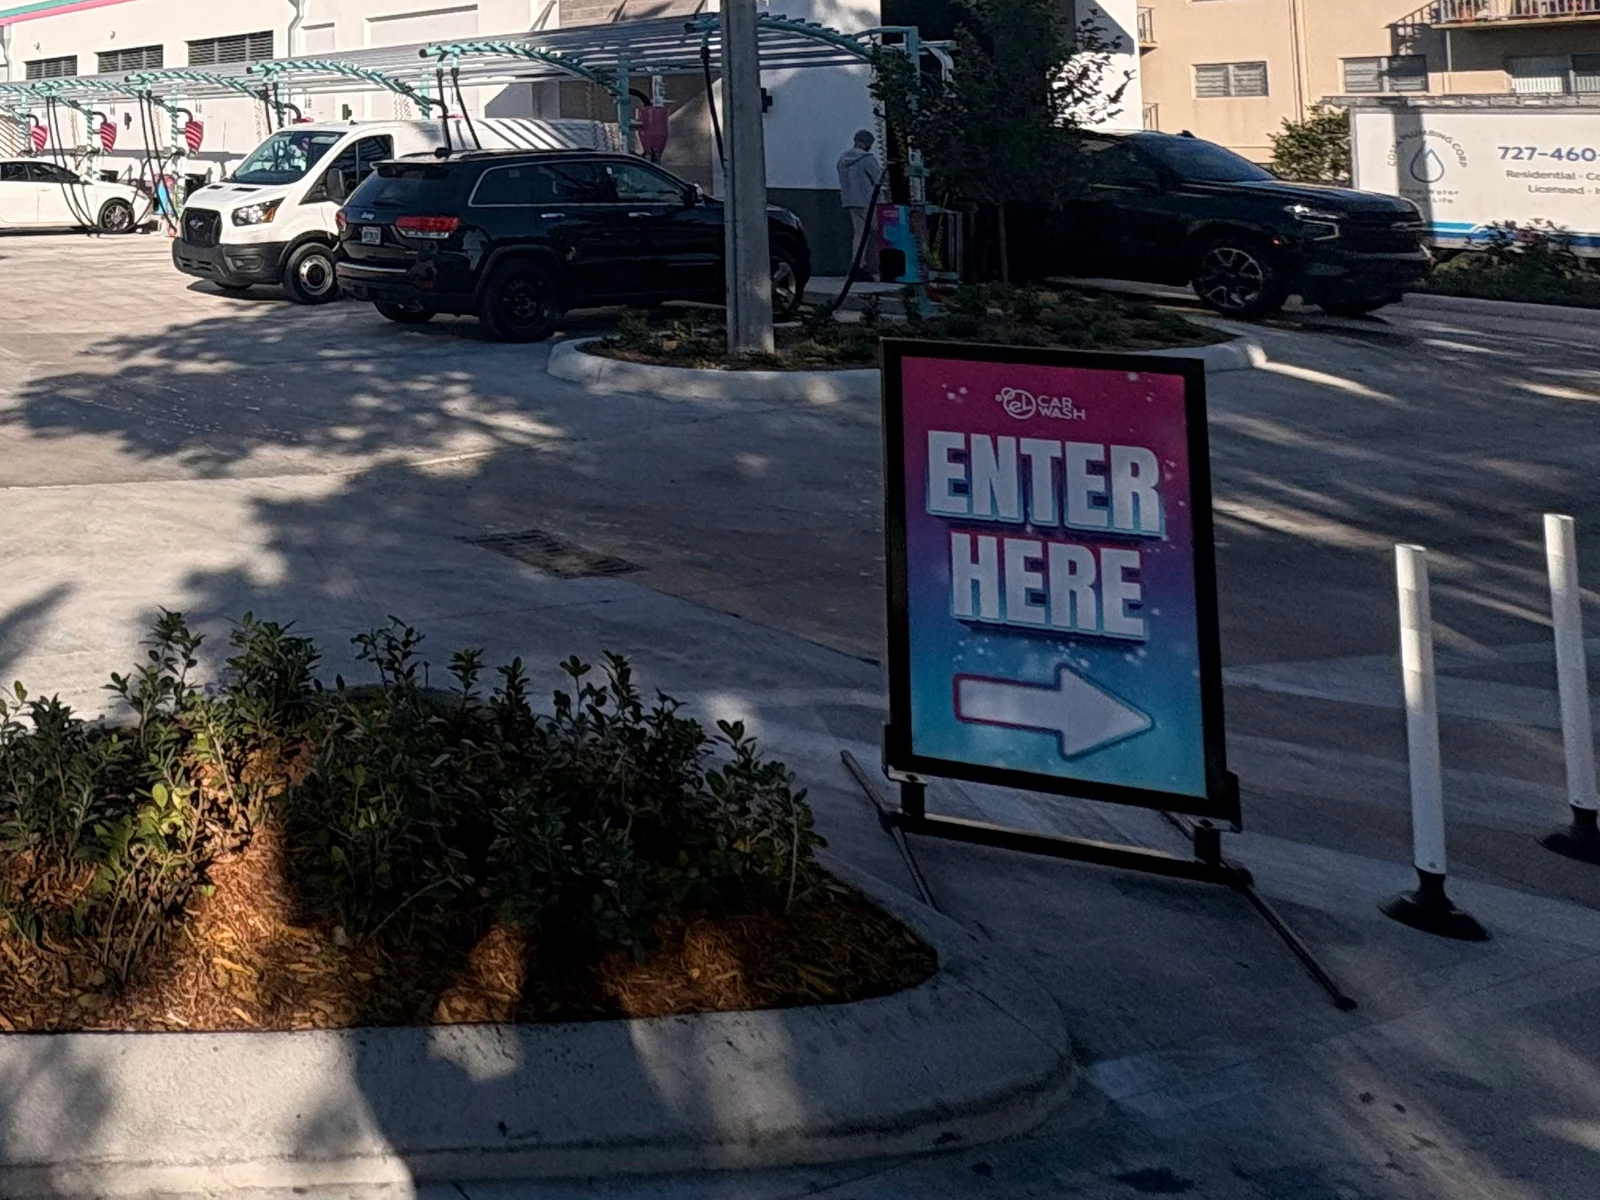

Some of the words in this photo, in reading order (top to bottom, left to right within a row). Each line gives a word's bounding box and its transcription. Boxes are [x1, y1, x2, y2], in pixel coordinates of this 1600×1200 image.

[1505, 169, 1576, 180] Residential
[1527, 184, 1585, 195] Licensed
[1036, 395, 1073, 409] CAR
[1037, 406, 1087, 421] WASH
[926, 430, 1165, 536] ENTER
[950, 531, 1147, 639] HERE
